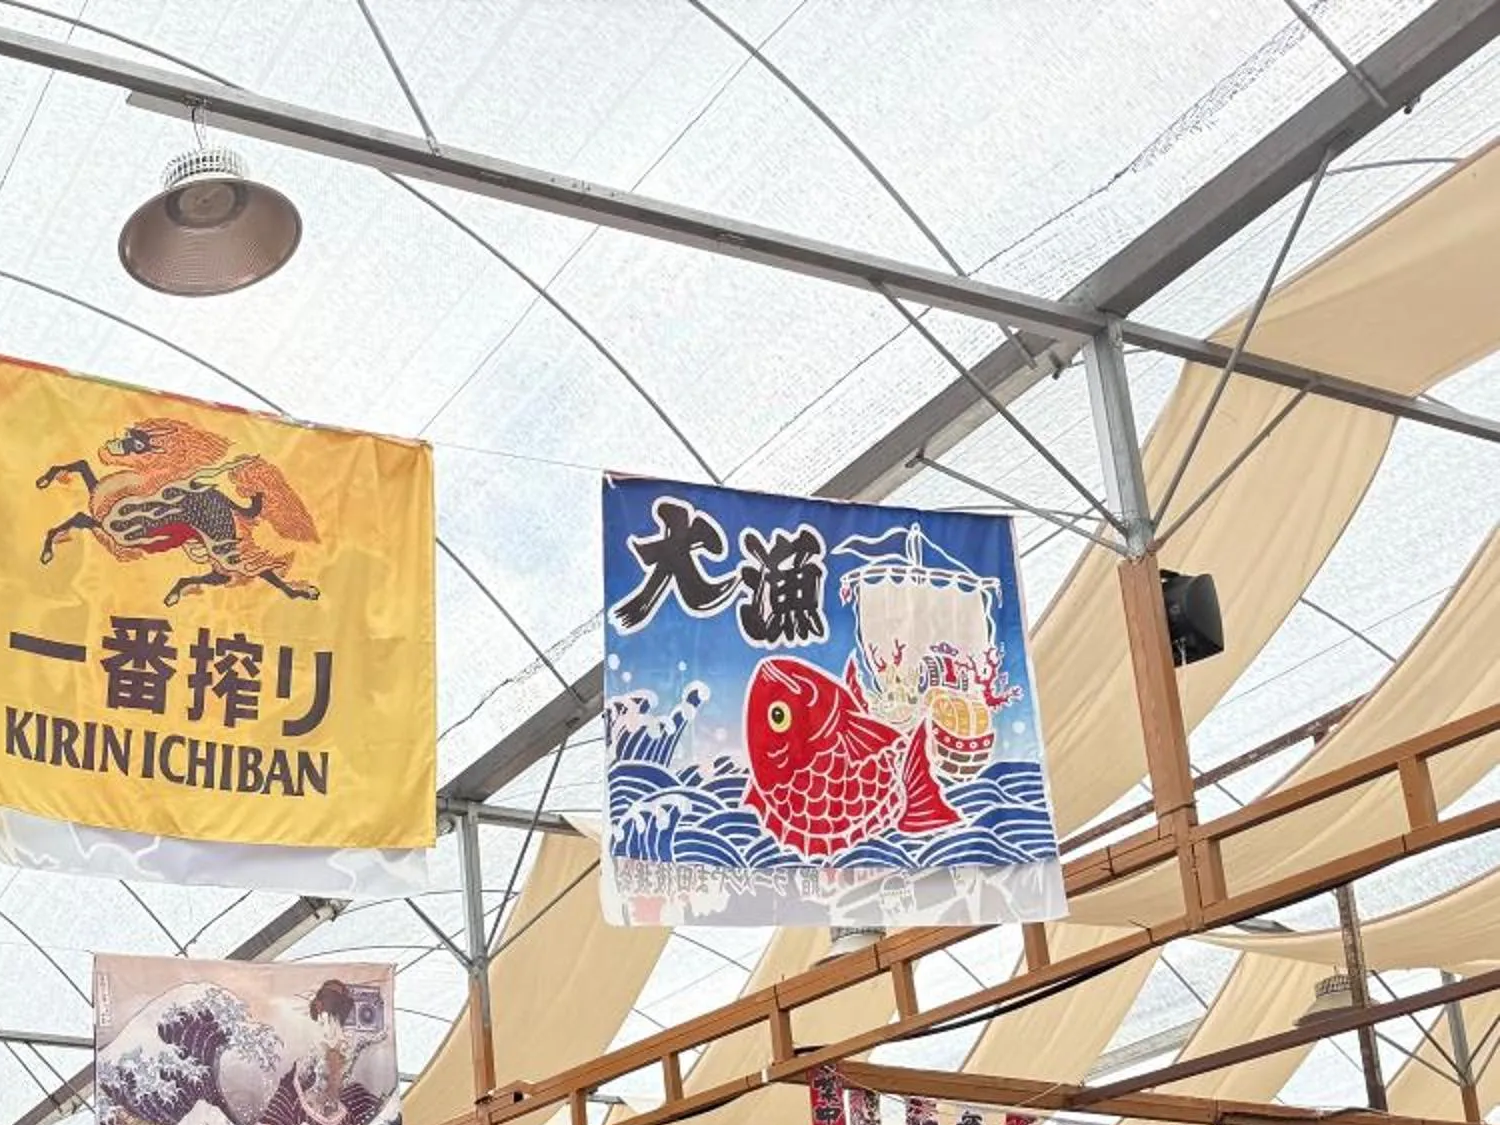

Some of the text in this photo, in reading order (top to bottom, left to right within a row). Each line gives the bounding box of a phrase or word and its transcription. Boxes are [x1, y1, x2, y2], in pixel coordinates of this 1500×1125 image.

[607, 497, 828, 648] 大漁
[5, 705, 330, 797] KIRIN ICHIBAN
